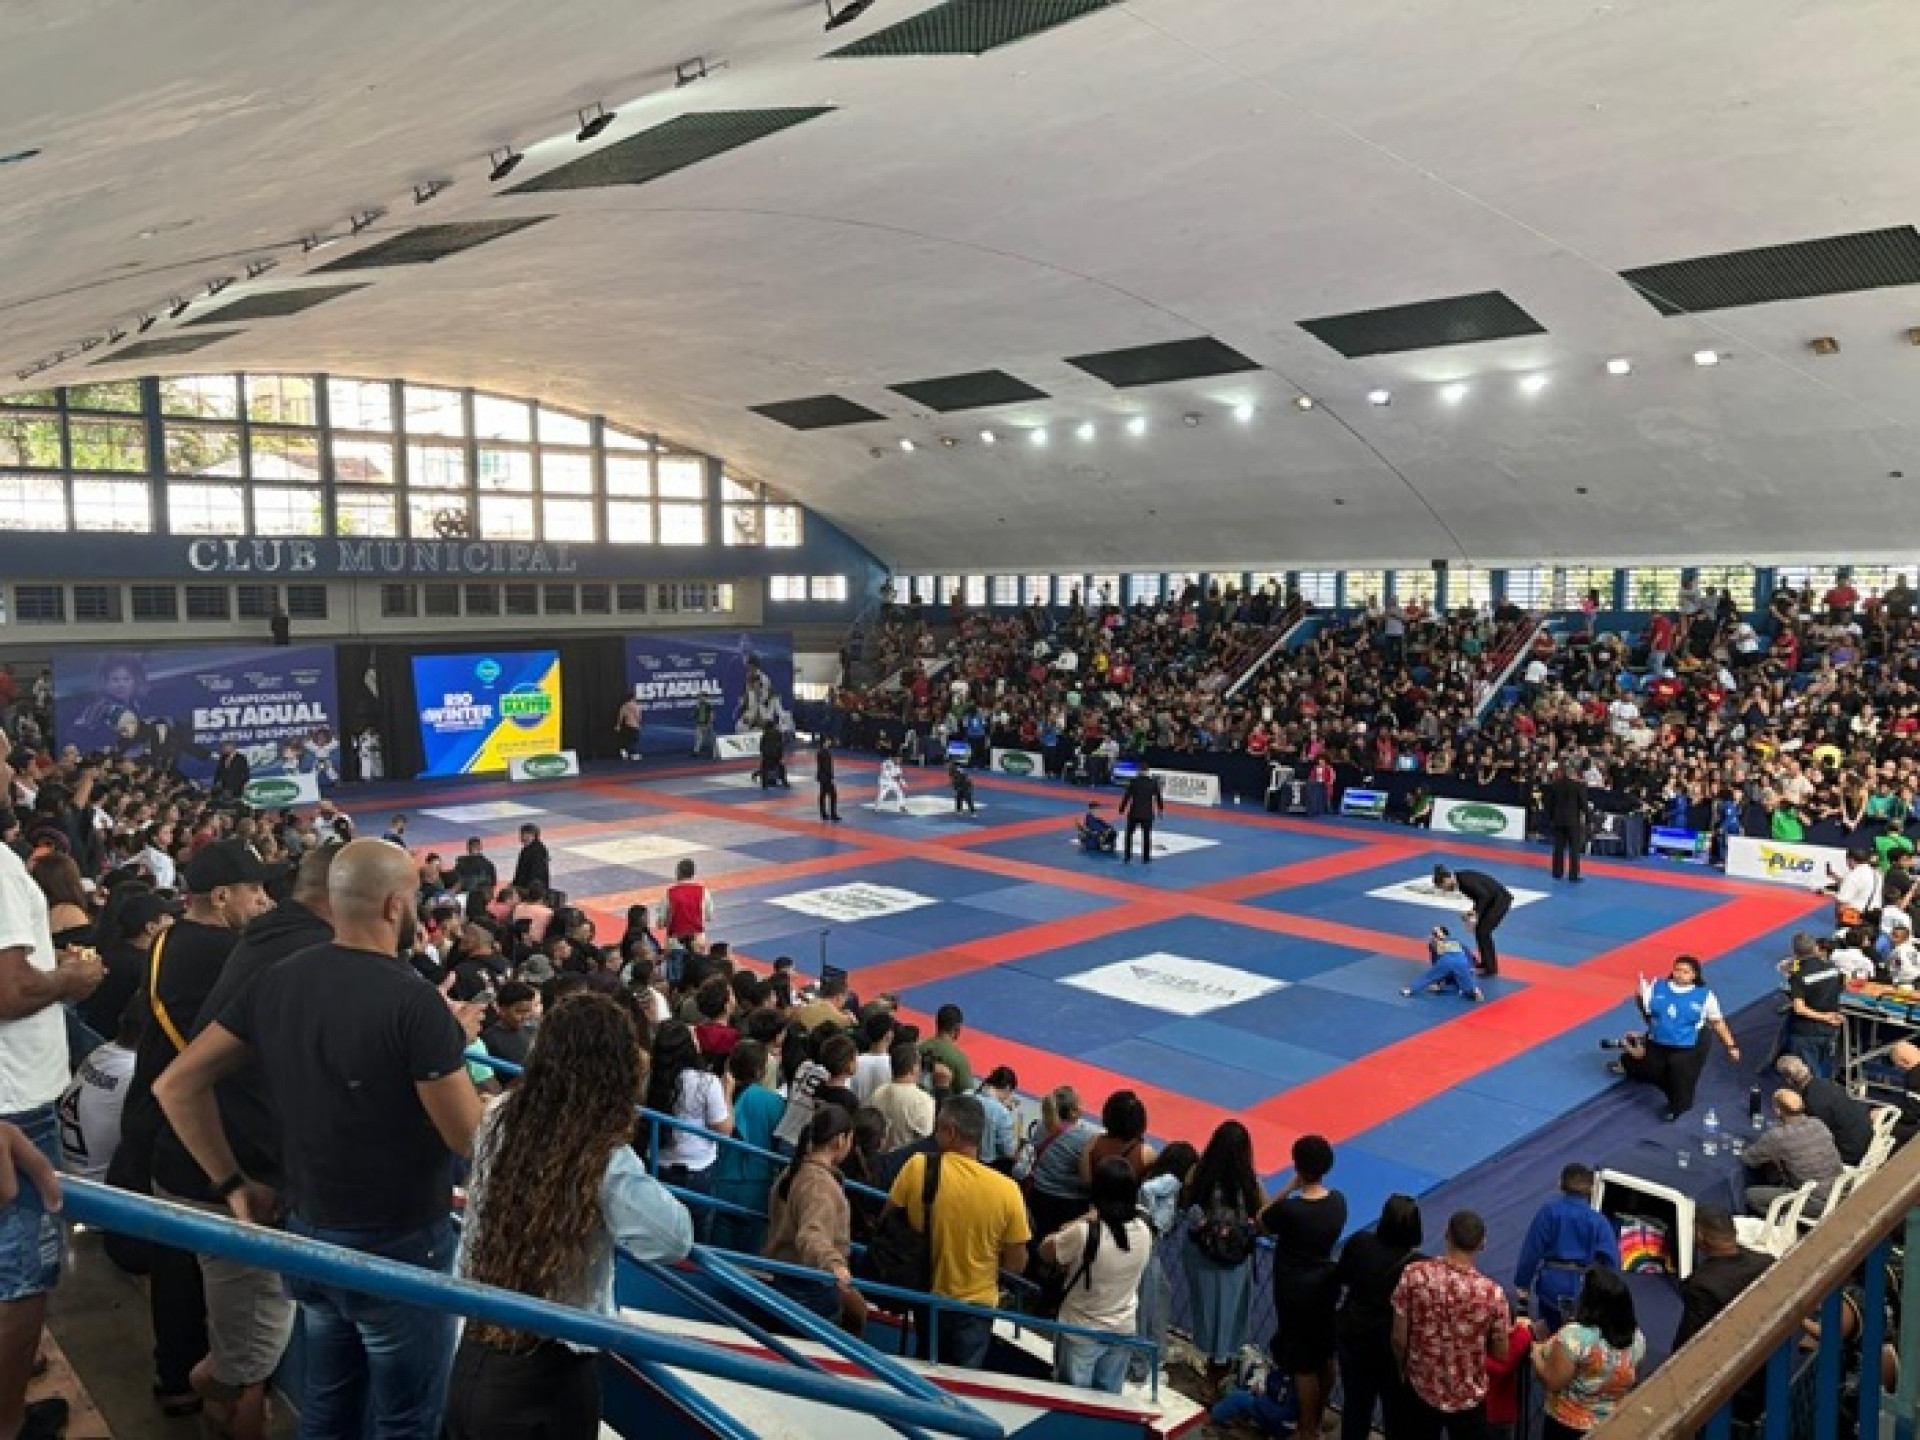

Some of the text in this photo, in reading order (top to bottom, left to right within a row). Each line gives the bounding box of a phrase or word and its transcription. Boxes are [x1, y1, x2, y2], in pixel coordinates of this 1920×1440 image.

[188, 539, 578, 573] CLUB MUNICIPAL
[220, 691, 303, 705] CAMPEONATO
[635, 679, 722, 700] ESTADUAL
[193, 702, 328, 730] ESTADUAL
[1767, 852, 1814, 873] PLUG
